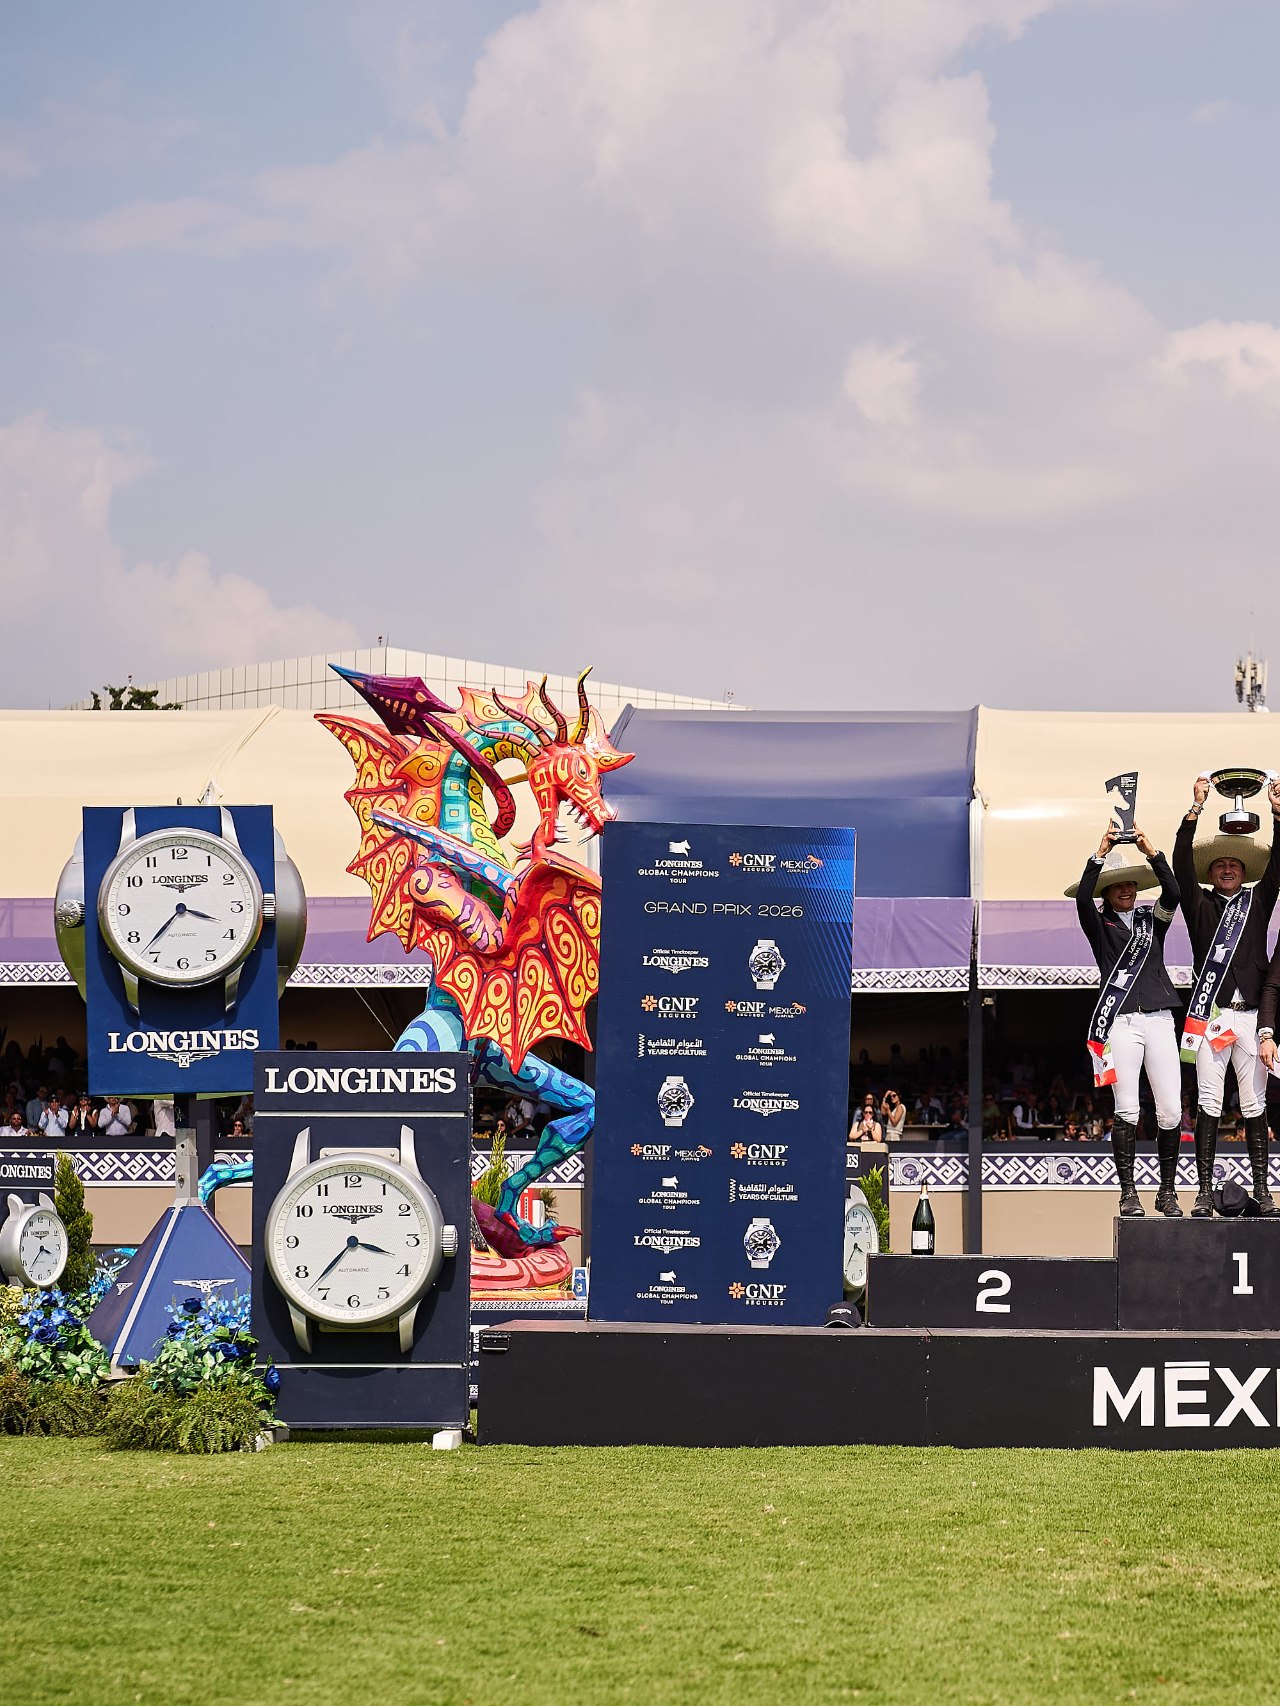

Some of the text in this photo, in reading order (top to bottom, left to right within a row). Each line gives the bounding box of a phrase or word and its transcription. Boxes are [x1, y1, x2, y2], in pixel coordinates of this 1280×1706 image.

[172, 848, 188, 860] 12
[744, 854, 776, 866] GNP
[146, 857, 156, 867] 11
[206, 855, 211, 866] 1
[655, 860, 703, 868] LONGINES
[780, 860, 818, 869] MEXICO
[127, 876, 143, 887] 10
[152, 875, 208, 883] LONGINES
[223, 874, 234, 885] 2
[118, 904, 131, 916] 9
[231, 901, 243, 913] 3
[644, 902, 803, 917] GRAND PRIX 2026
[127, 931, 140, 943] 8
[222, 929, 236, 940] 4
[149, 951, 160, 963] 7
[205, 950, 217, 961] 5
[643, 956, 708, 967] LONGINES
[177, 958, 189, 970] 6
[1195, 971, 1216, 1016] 2026
[658, 997, 699, 1011] GNP
[737, 1002, 766, 1011] GNP
[769, 1006, 802, 1015] MEXICO
[1096, 995, 1116, 1039] 2026
[108, 1030, 259, 1054] LONGINES
[265, 1068, 456, 1093] LONGINES
[733, 1099, 799, 1110] LONGINES
[643, 1145, 671, 1155] GNP
[674, 1150, 708, 1158] MEXICO
[748, 1144, 788, 1158] GNP
[0, 1165, 52, 1179] ONGINES
[343, 1175, 362, 1188] 12
[317, 1184, 328, 1196] 11
[381, 1184, 386, 1195] 1
[296, 1205, 313, 1217] 10
[323, 1205, 383, 1214] LONGINES
[398, 1204, 411, 1216] 2
[286, 1235, 299, 1248] 9
[406, 1234, 420, 1247] 3
[634, 1236, 700, 1247] LONGINES
[295, 1265, 309, 1278] 8
[396, 1264, 411, 1276] 4
[1232, 1252, 1254, 1295] 1
[317, 1288, 330, 1300] 7
[377, 1287, 390, 1299] 5
[746, 1284, 786, 1298] GNP
[976, 1270, 1012, 1313] 2
[347, 1295, 361, 1308] 6
